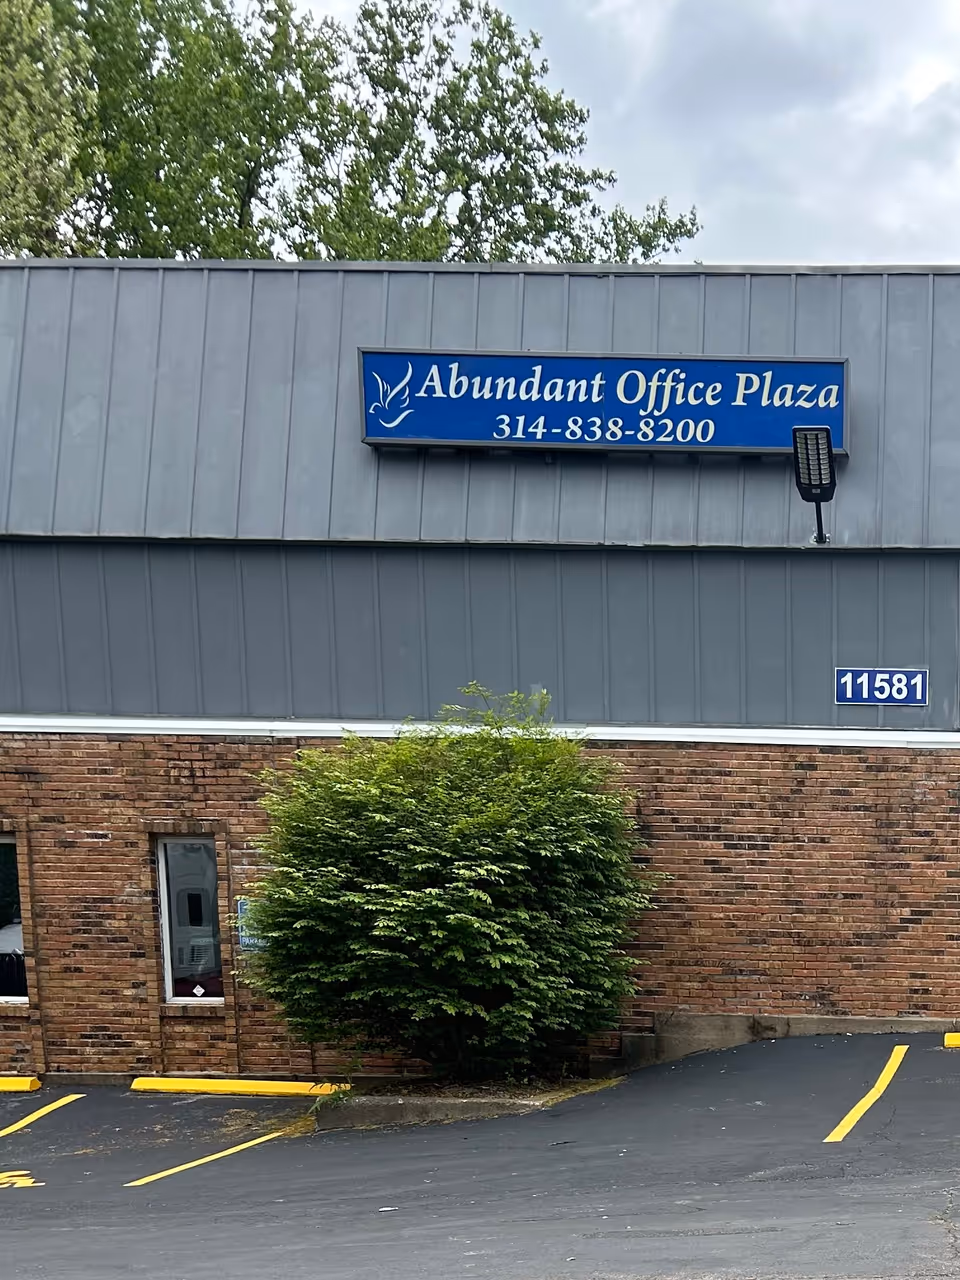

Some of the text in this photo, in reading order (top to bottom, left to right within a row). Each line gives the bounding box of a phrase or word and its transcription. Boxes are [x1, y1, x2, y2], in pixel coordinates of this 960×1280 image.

[415, 362, 839, 417] Abundant Office Plaza
[493, 414, 715, 443] 314-838-8200
[840, 672, 923, 700] 11581
